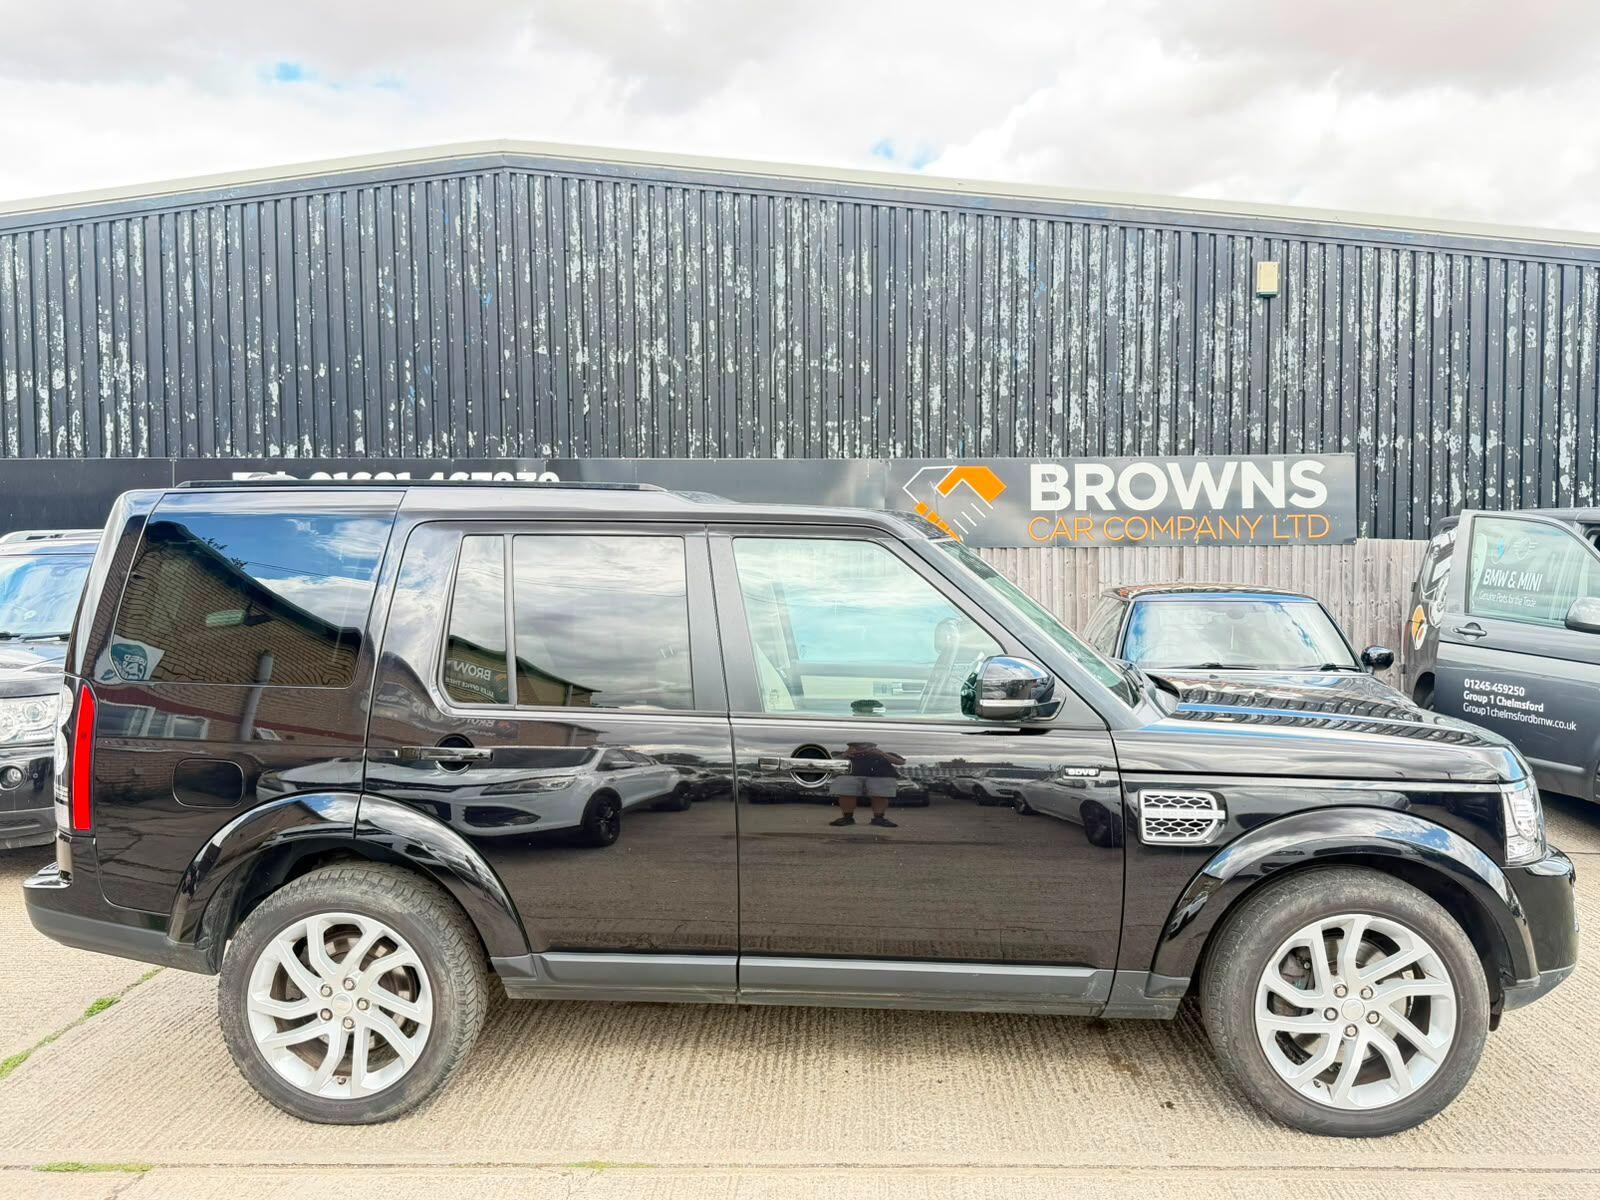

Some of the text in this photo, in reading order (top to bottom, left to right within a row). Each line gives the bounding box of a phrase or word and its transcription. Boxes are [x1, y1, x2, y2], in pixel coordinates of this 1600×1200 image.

[1030, 460, 1327, 511] BROWNS
[1028, 513, 1331, 542] CAR COMPANY LTD
[1483, 569, 1508, 587] BMW
[1517, 572, 1543, 591] MINI
[1462, 690, 1544, 712] Group 1 Chelmsford
